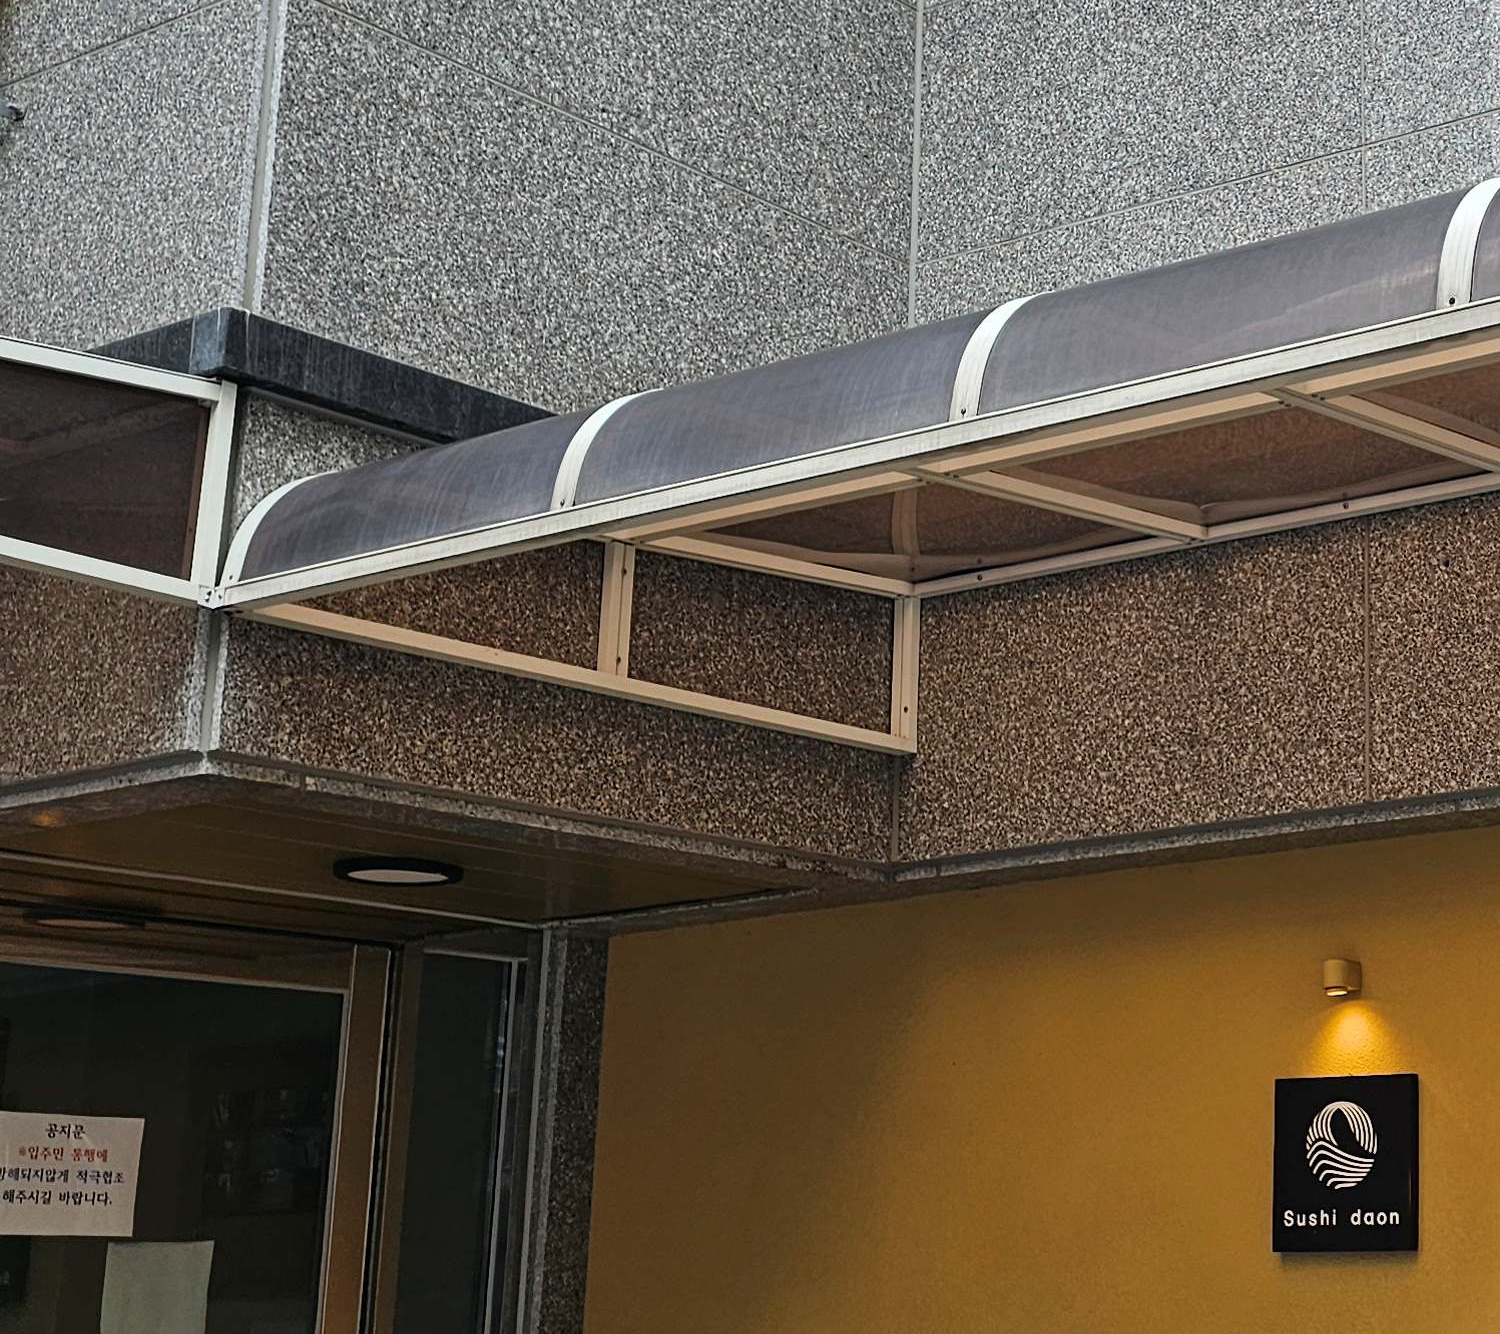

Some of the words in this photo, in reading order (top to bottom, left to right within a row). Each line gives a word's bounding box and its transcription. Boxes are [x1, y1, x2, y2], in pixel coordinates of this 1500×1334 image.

[45, 1123, 86, 1139] 공지문
[76, 1169, 125, 1185] 적극협조
[2, 1189, 52, 1205] 해주시길
[58, 1190, 113, 1207] 바랍니다.
[1283, 1208, 1336, 1227] Sushi
[1350, 1208, 1400, 1226] daon
